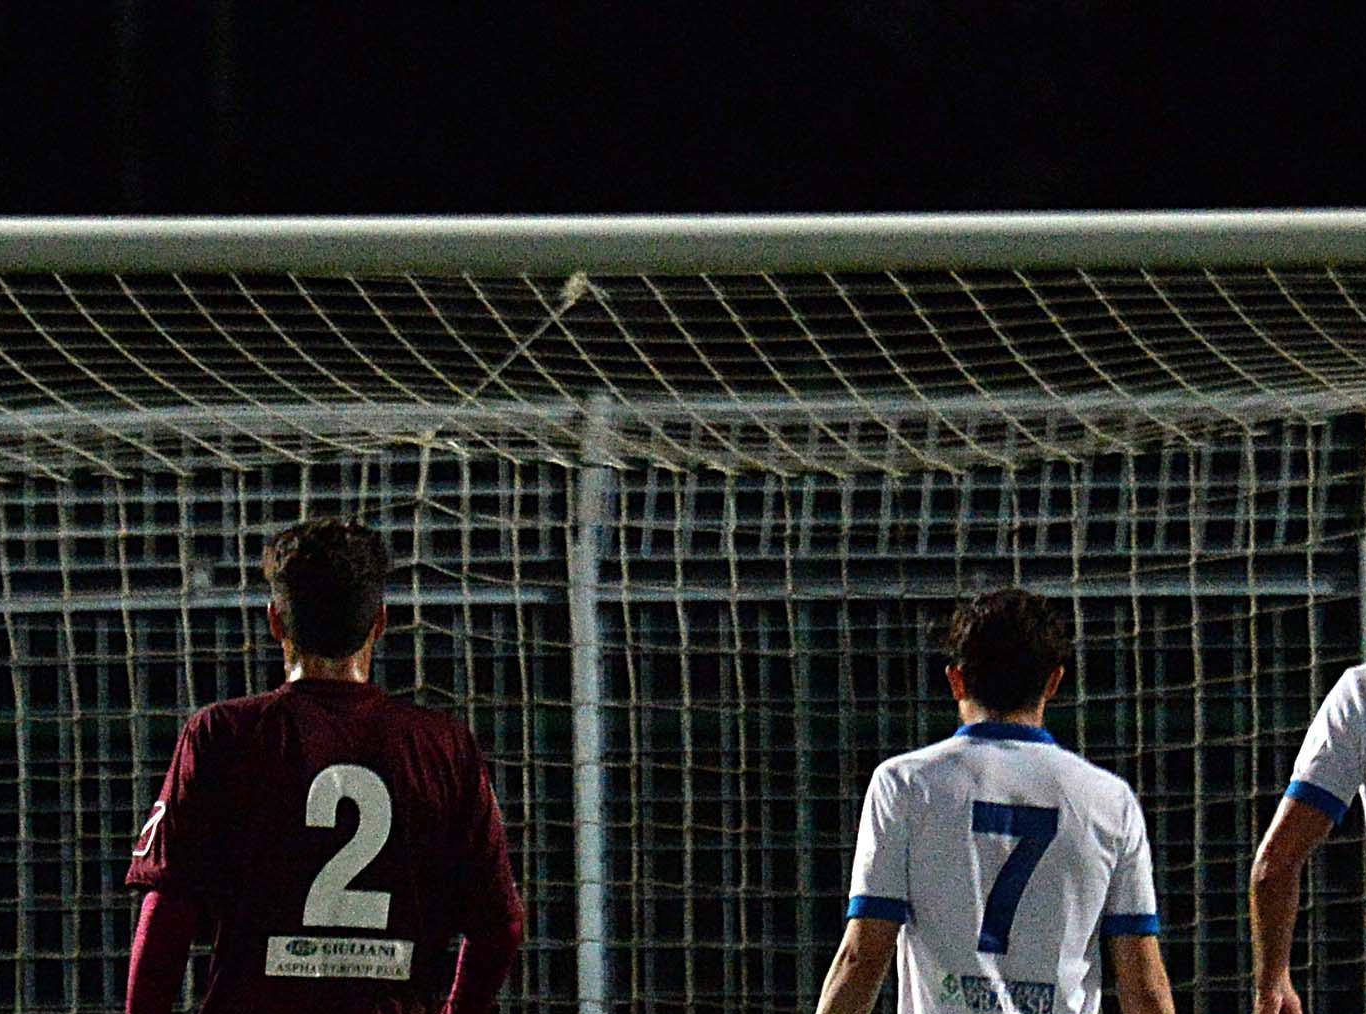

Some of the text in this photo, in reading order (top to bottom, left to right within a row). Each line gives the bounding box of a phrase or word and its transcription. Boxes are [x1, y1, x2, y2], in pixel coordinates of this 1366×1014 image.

[303, 764, 392, 929] 2
[972, 800, 1059, 955] 7
[322, 942, 396, 958] GIULIANI
